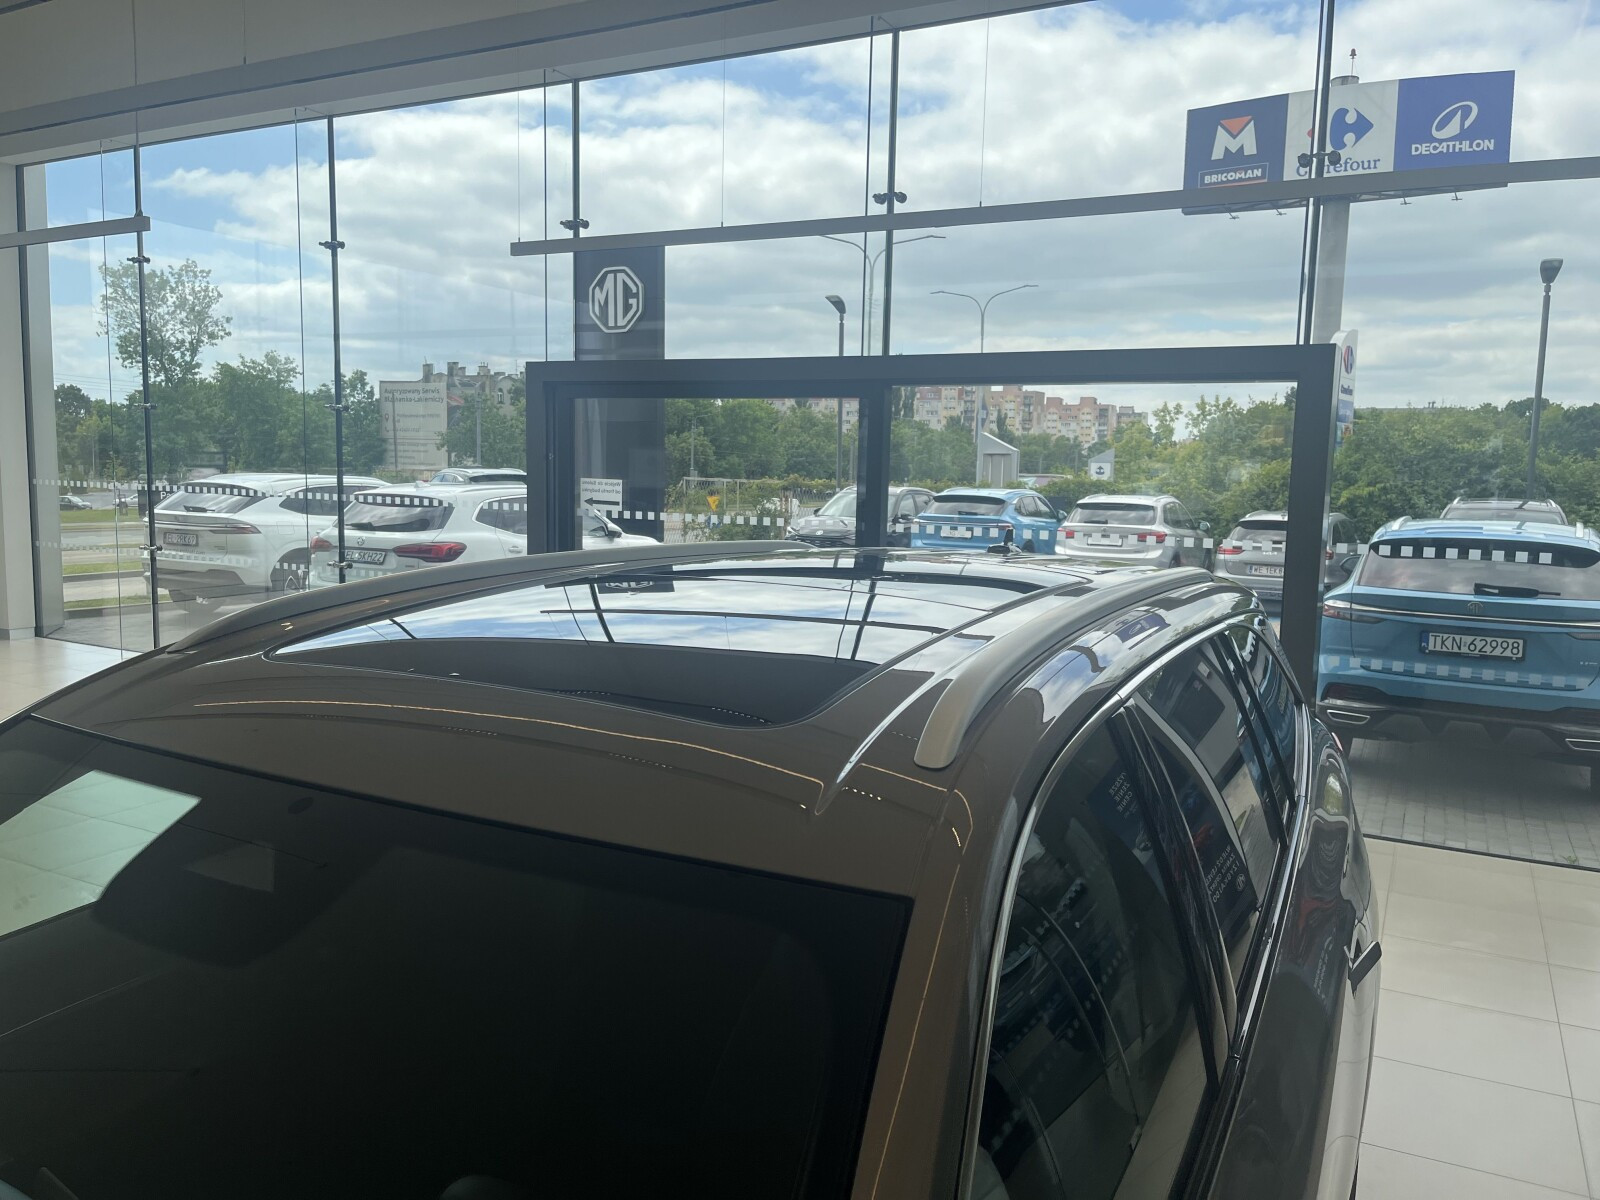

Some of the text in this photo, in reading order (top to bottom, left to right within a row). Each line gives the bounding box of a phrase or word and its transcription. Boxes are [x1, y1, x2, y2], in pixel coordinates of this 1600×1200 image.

[1411, 139, 1494, 155] DECATHLON
[1204, 168, 1262, 184] BRICOMAN
[1296, 157, 1380, 177] Crefour
[594, 272, 638, 327] MG
[1431, 634, 1462, 651] TKN
[1467, 638, 1520, 656] 62998
